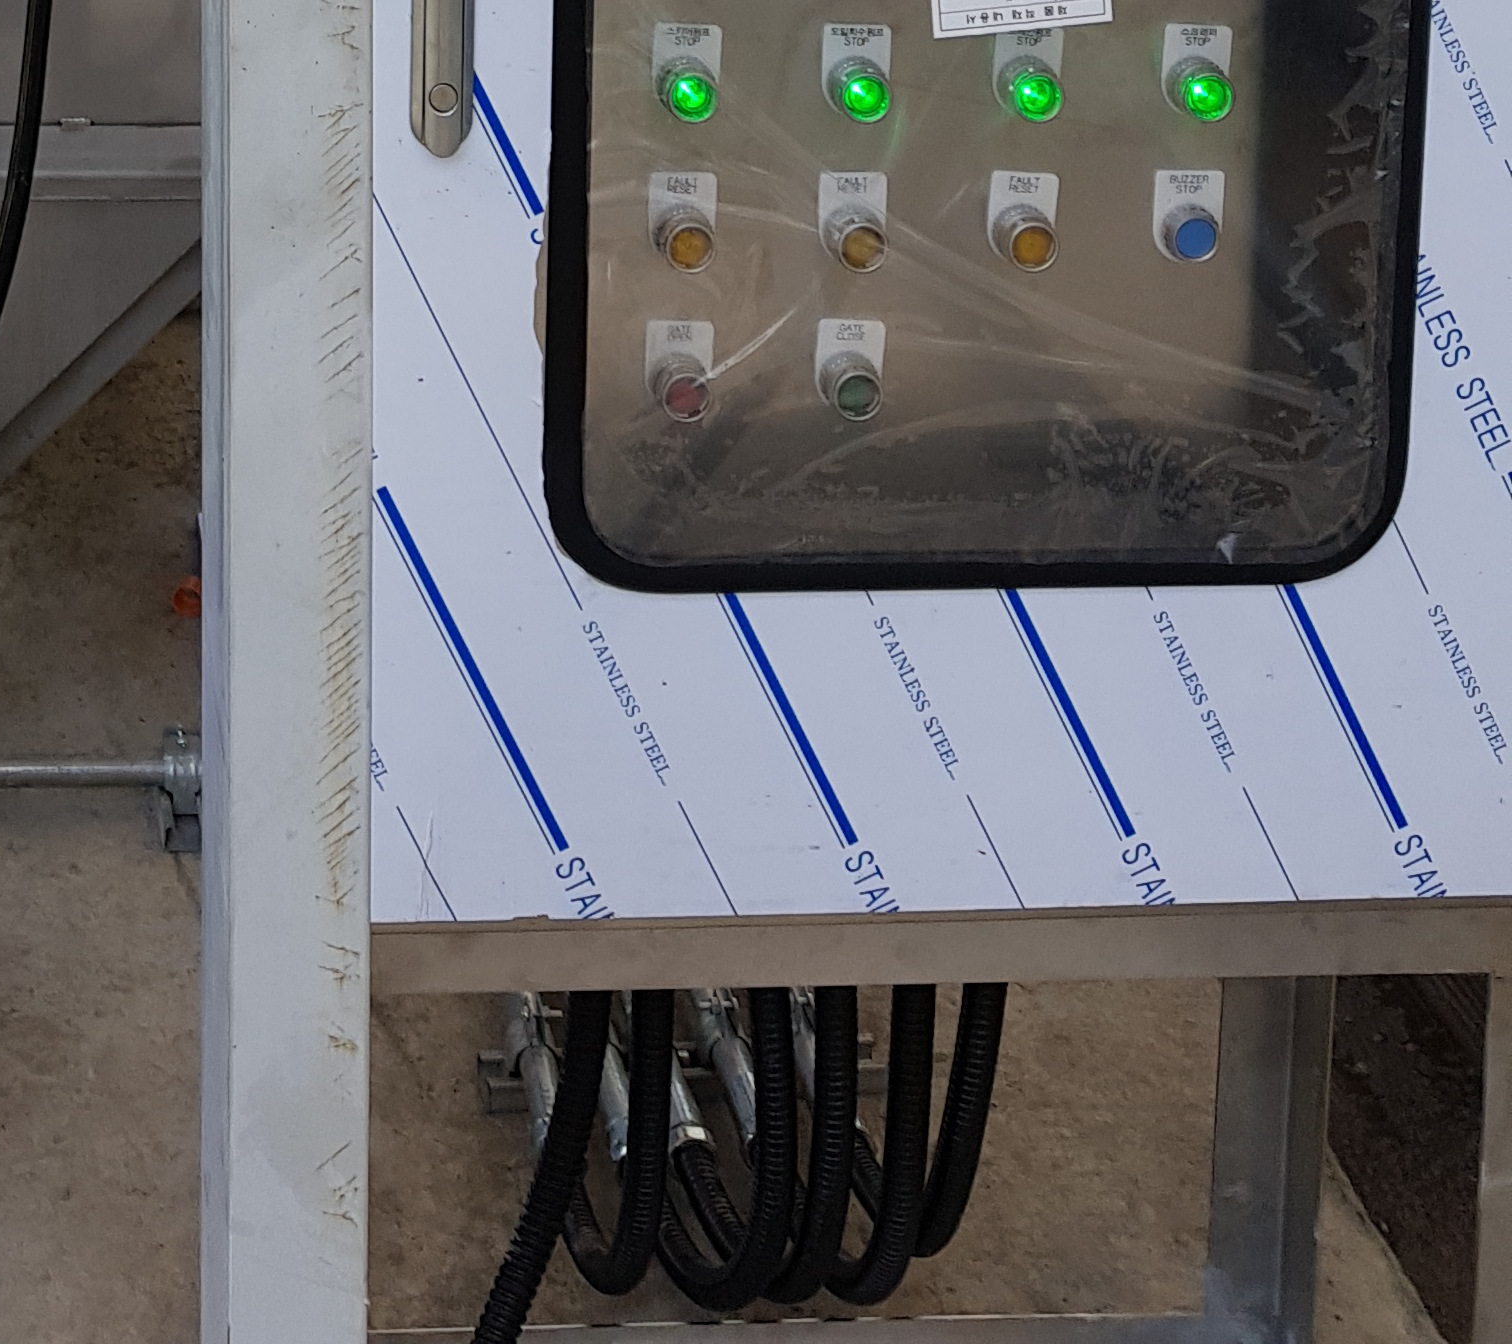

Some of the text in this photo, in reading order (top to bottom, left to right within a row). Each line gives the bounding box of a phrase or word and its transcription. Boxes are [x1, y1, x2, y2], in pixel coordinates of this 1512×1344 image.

[965, 11, 1004, 25] 내용서
[674, 36, 700, 47] STOP
[843, 37, 870, 47] STOP
[1016, 37, 1042, 47] STOP
[1185, 37, 1211, 47] STOP
[1463, 77, 1498, 145] STEEL
[666, 176, 697, 186] FAULT
[837, 176, 868, 186] FAULT
[1009, 176, 1040, 185] FAULT
[1169, 175, 1209, 184] BUZZER
[666, 185, 697, 194] RESET
[1008, 184, 1039, 194] RESET
[1175, 185, 1202, 194] STOP
[839, 324, 864, 333] GATE
[836, 332, 866, 341] CLOSE
[1456, 377, 1511, 472] STEEL
[1428, 604, 1507, 765] STAINLESS STEEL
[1153, 611, 1236, 774] STAINLESS STEEL
[873, 616, 959, 781] STAINLESS STEEL
[583, 621, 671, 787] STAINLESS STEEL
